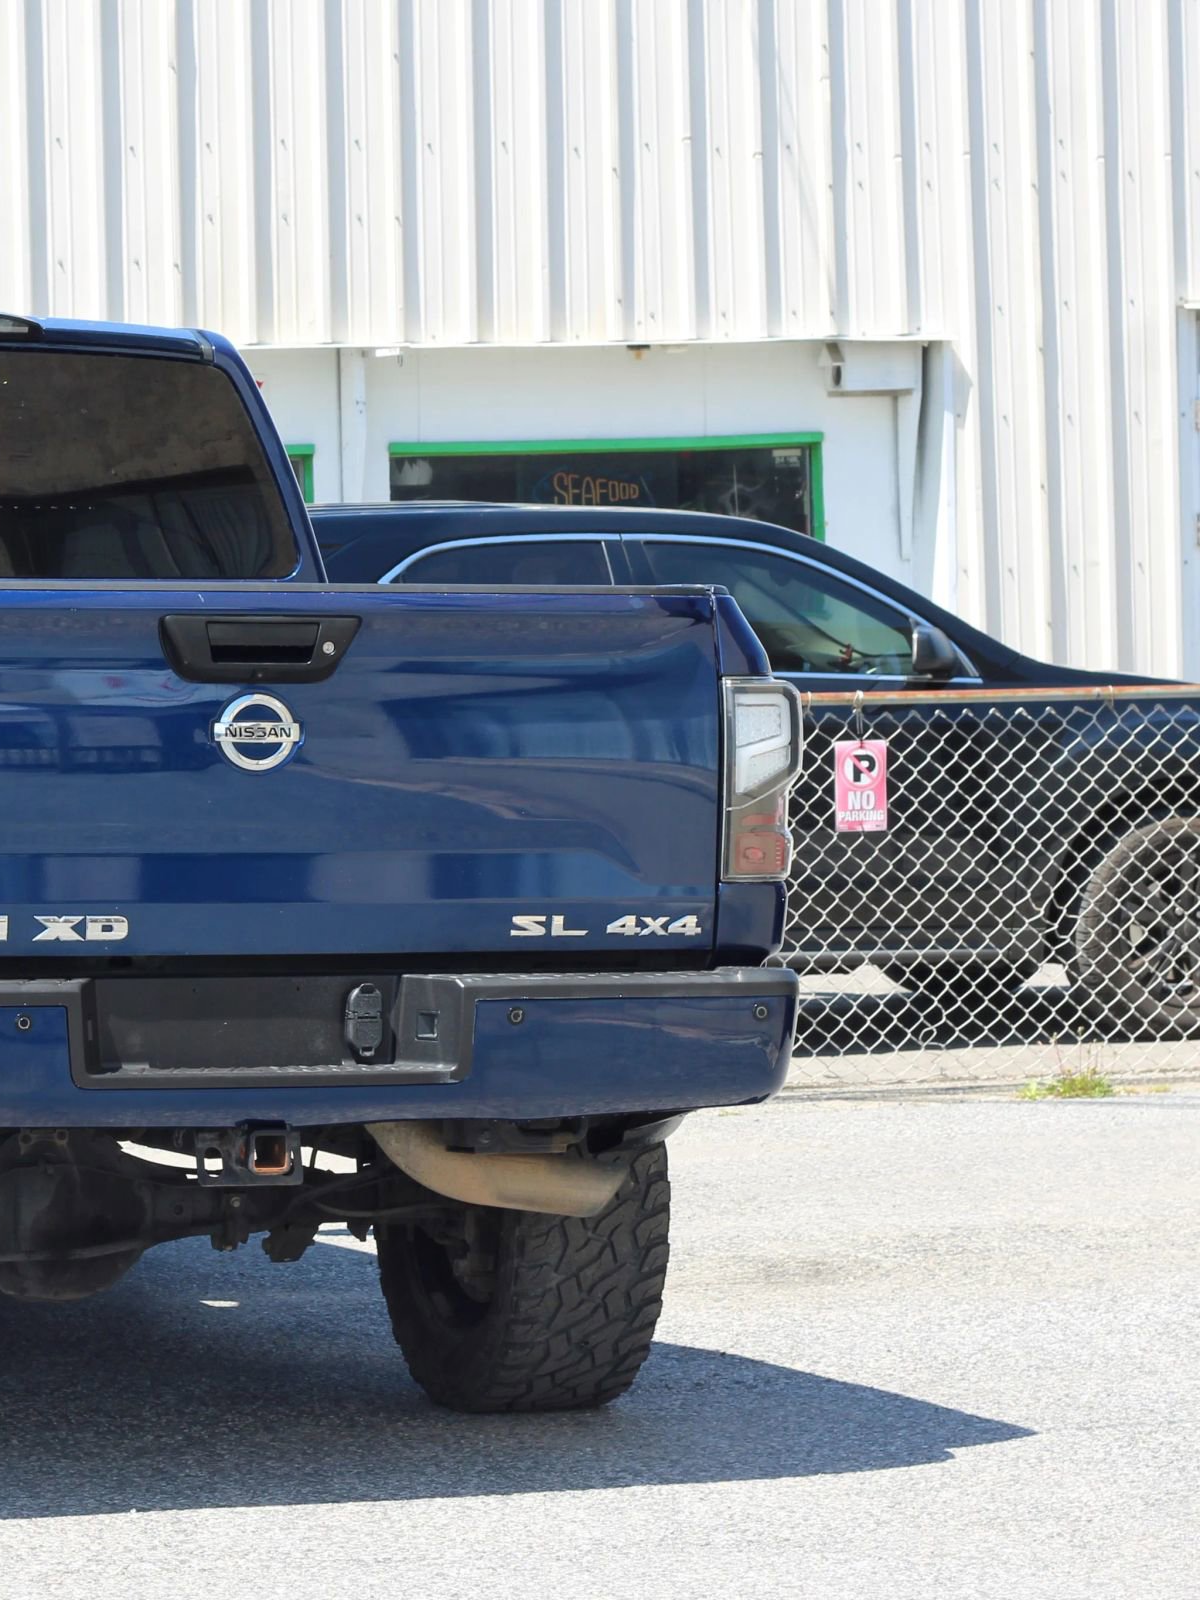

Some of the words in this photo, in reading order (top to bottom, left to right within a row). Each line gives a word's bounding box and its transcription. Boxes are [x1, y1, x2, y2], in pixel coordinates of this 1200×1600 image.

[553, 471, 640, 505] SEAFOOD
[224, 727, 292, 738] NISSAN
[848, 791, 875, 810] NO
[838, 810, 885, 821] PARKING
[32, 915, 129, 942] XD
[510, 915, 588, 936] SL
